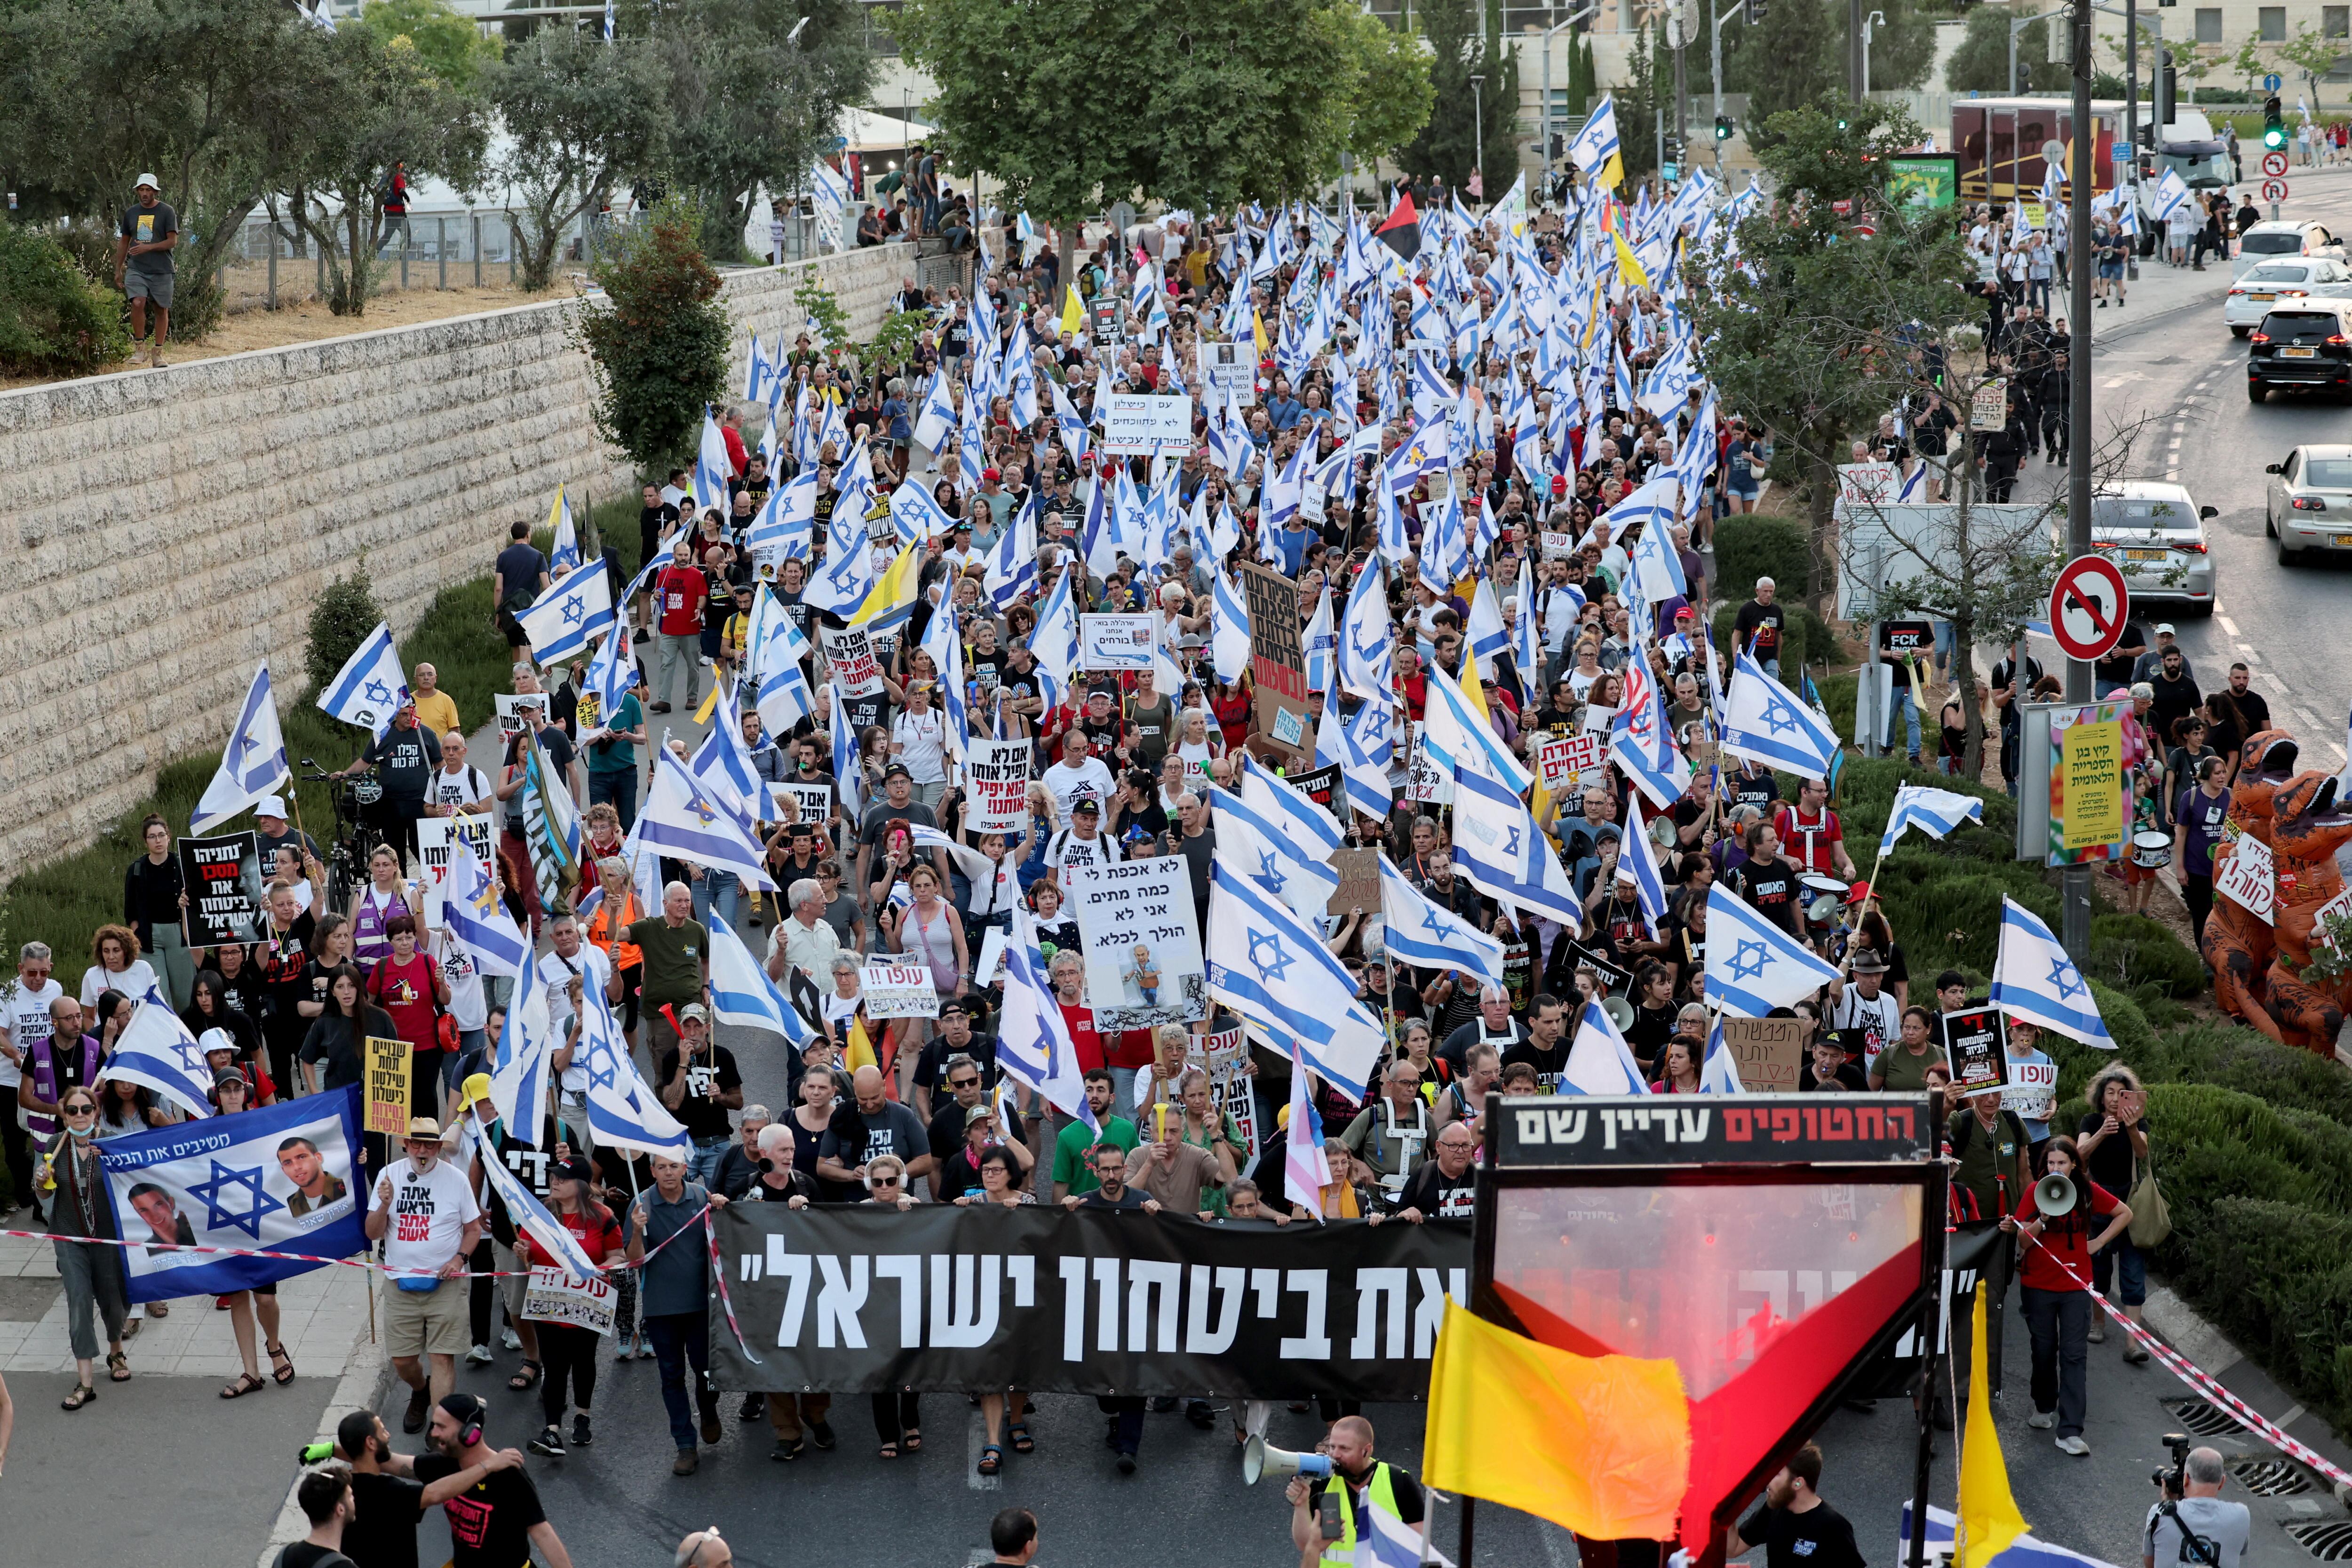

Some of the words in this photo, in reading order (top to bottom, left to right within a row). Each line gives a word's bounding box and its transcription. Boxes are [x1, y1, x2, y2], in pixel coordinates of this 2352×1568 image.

[1098, 309, 1114, 318] מסכן
[1101, 316, 1111, 325] את
[1113, 398, 1145, 410] כישלון
[1158, 401, 1172, 410] עם
[1972, 395, 2002, 404] סכנה
[1110, 418, 1158, 427] מתווכחים.
[1164, 419, 1178, 428] לא
[1104, 434, 1144, 445] עכשיו!
[1308, 495, 1321, 507] אוכלי
[1307, 509, 1319, 519] מוות
[866, 515, 892, 539] NOW!
[1548, 533, 1566, 546] עופו
[1246, 568, 1293, 608] הפקרתם
[667, 593, 683, 601] אתה
[667, 601, 683, 609] אשם
[1250, 591, 1296, 629] פילגתם
[834, 633, 849, 647] לא
[850, 629, 866, 645] אם
[1891, 635, 1920, 646] FCK
[825, 645, 844, 660] אותו
[845, 643, 868, 660] נפיל
[1255, 636, 1303, 674] הרסתם
[831, 659, 850, 672] יפיל
[854, 653, 873, 667] הוא
[843, 665, 875, 685] אותנו!
[858, 703, 877, 715] קפלן
[851, 715, 866, 725] כוח
[866, 715, 876, 725] זה
[397, 744, 419, 756] קפלן
[991, 742, 1009, 764] לא
[1012, 745, 1027, 762] אם
[1540, 736, 1594, 762] ובחרת
[2075, 747, 2090, 760] בגן
[2098, 745, 2109, 757] קיץ
[391, 757, 406, 769] כוח
[410, 756, 420, 767] זה
[1543, 752, 1595, 779] בחיים
[2072, 758, 2114, 772] הספרייה
[971, 762, 1002, 781] אותו
[1004, 762, 1026, 781] נפיל
[2072, 771, 2114, 787] הלאומית
[442, 785, 461, 796] אתה
[976, 779, 1003, 797] יפיל
[1005, 779, 1025, 797] הוא
[1736, 791, 1768, 802] נאמנים
[987, 796, 1024, 815] אותנו!
[2072, 835, 2097, 844] nli.org.il
[193, 843, 242, 863] "נתניהו
[1069, 844, 1092, 856] אתה
[1064, 854, 1094, 866] הראש
[1159, 859, 1179, 874] לא
[201, 863, 238, 881] מסכן
[1084, 868, 1100, 882] לי
[1107, 865, 1150, 880] אכפת
[2245, 864, 2269, 879] את
[211, 879, 233, 895] את
[1137, 883, 1170, 900] כמה
[1755, 880, 1786, 896] האשם
[1087, 887, 1130, 905] מתים.
[200, 895, 249, 914] ביטחון
[1144, 902, 1168, 917] אני
[1115, 907, 1135, 923] לא
[1095, 929, 1139, 948] לכלא.
[1148, 925, 1185, 943] הולך
[898, 952, 914, 964] משטרת
[869, 968, 881, 985] !!
[886, 968, 923, 986] עופו
[20, 1013, 40, 1023] כיפור
[1961, 1013, 1984, 1033] די
[1722, 1019, 1801, 1043] הממשלה
[1201, 1029, 1238, 1051] עופו
[1956, 1032, 1994, 1048] להשתמטות
[373, 1040, 406, 1059] שבויים
[1735, 1044, 1773, 1062] יותר
[1965, 1043, 1987, 1057] ולביזה
[378, 1054, 399, 1072] תחת
[372, 1070, 405, 1089] שילטון
[2020, 1066, 2054, 1085] עופו
[373, 1085, 405, 1104] כישלון
[372, 1101, 405, 1120] בחירות
[372, 1116, 405, 1134] עכשיו!
[1516, 1109, 1588, 1144] שם
[1600, 1108, 1711, 1150] עדיין
[1722, 1106, 1915, 1142] החטופים
[148, 1148, 170, 1162] את
[402, 1186, 431, 1201] אתה
[397, 1199, 435, 1215] הראש
[298, 1213, 324, 1230] שאול
[399, 1214, 430, 1228] אתה
[397, 1226, 429, 1242] אשם
[740, 1234, 1035, 1349] ישראל"
[1059, 1256, 1331, 1362] ביטחון
